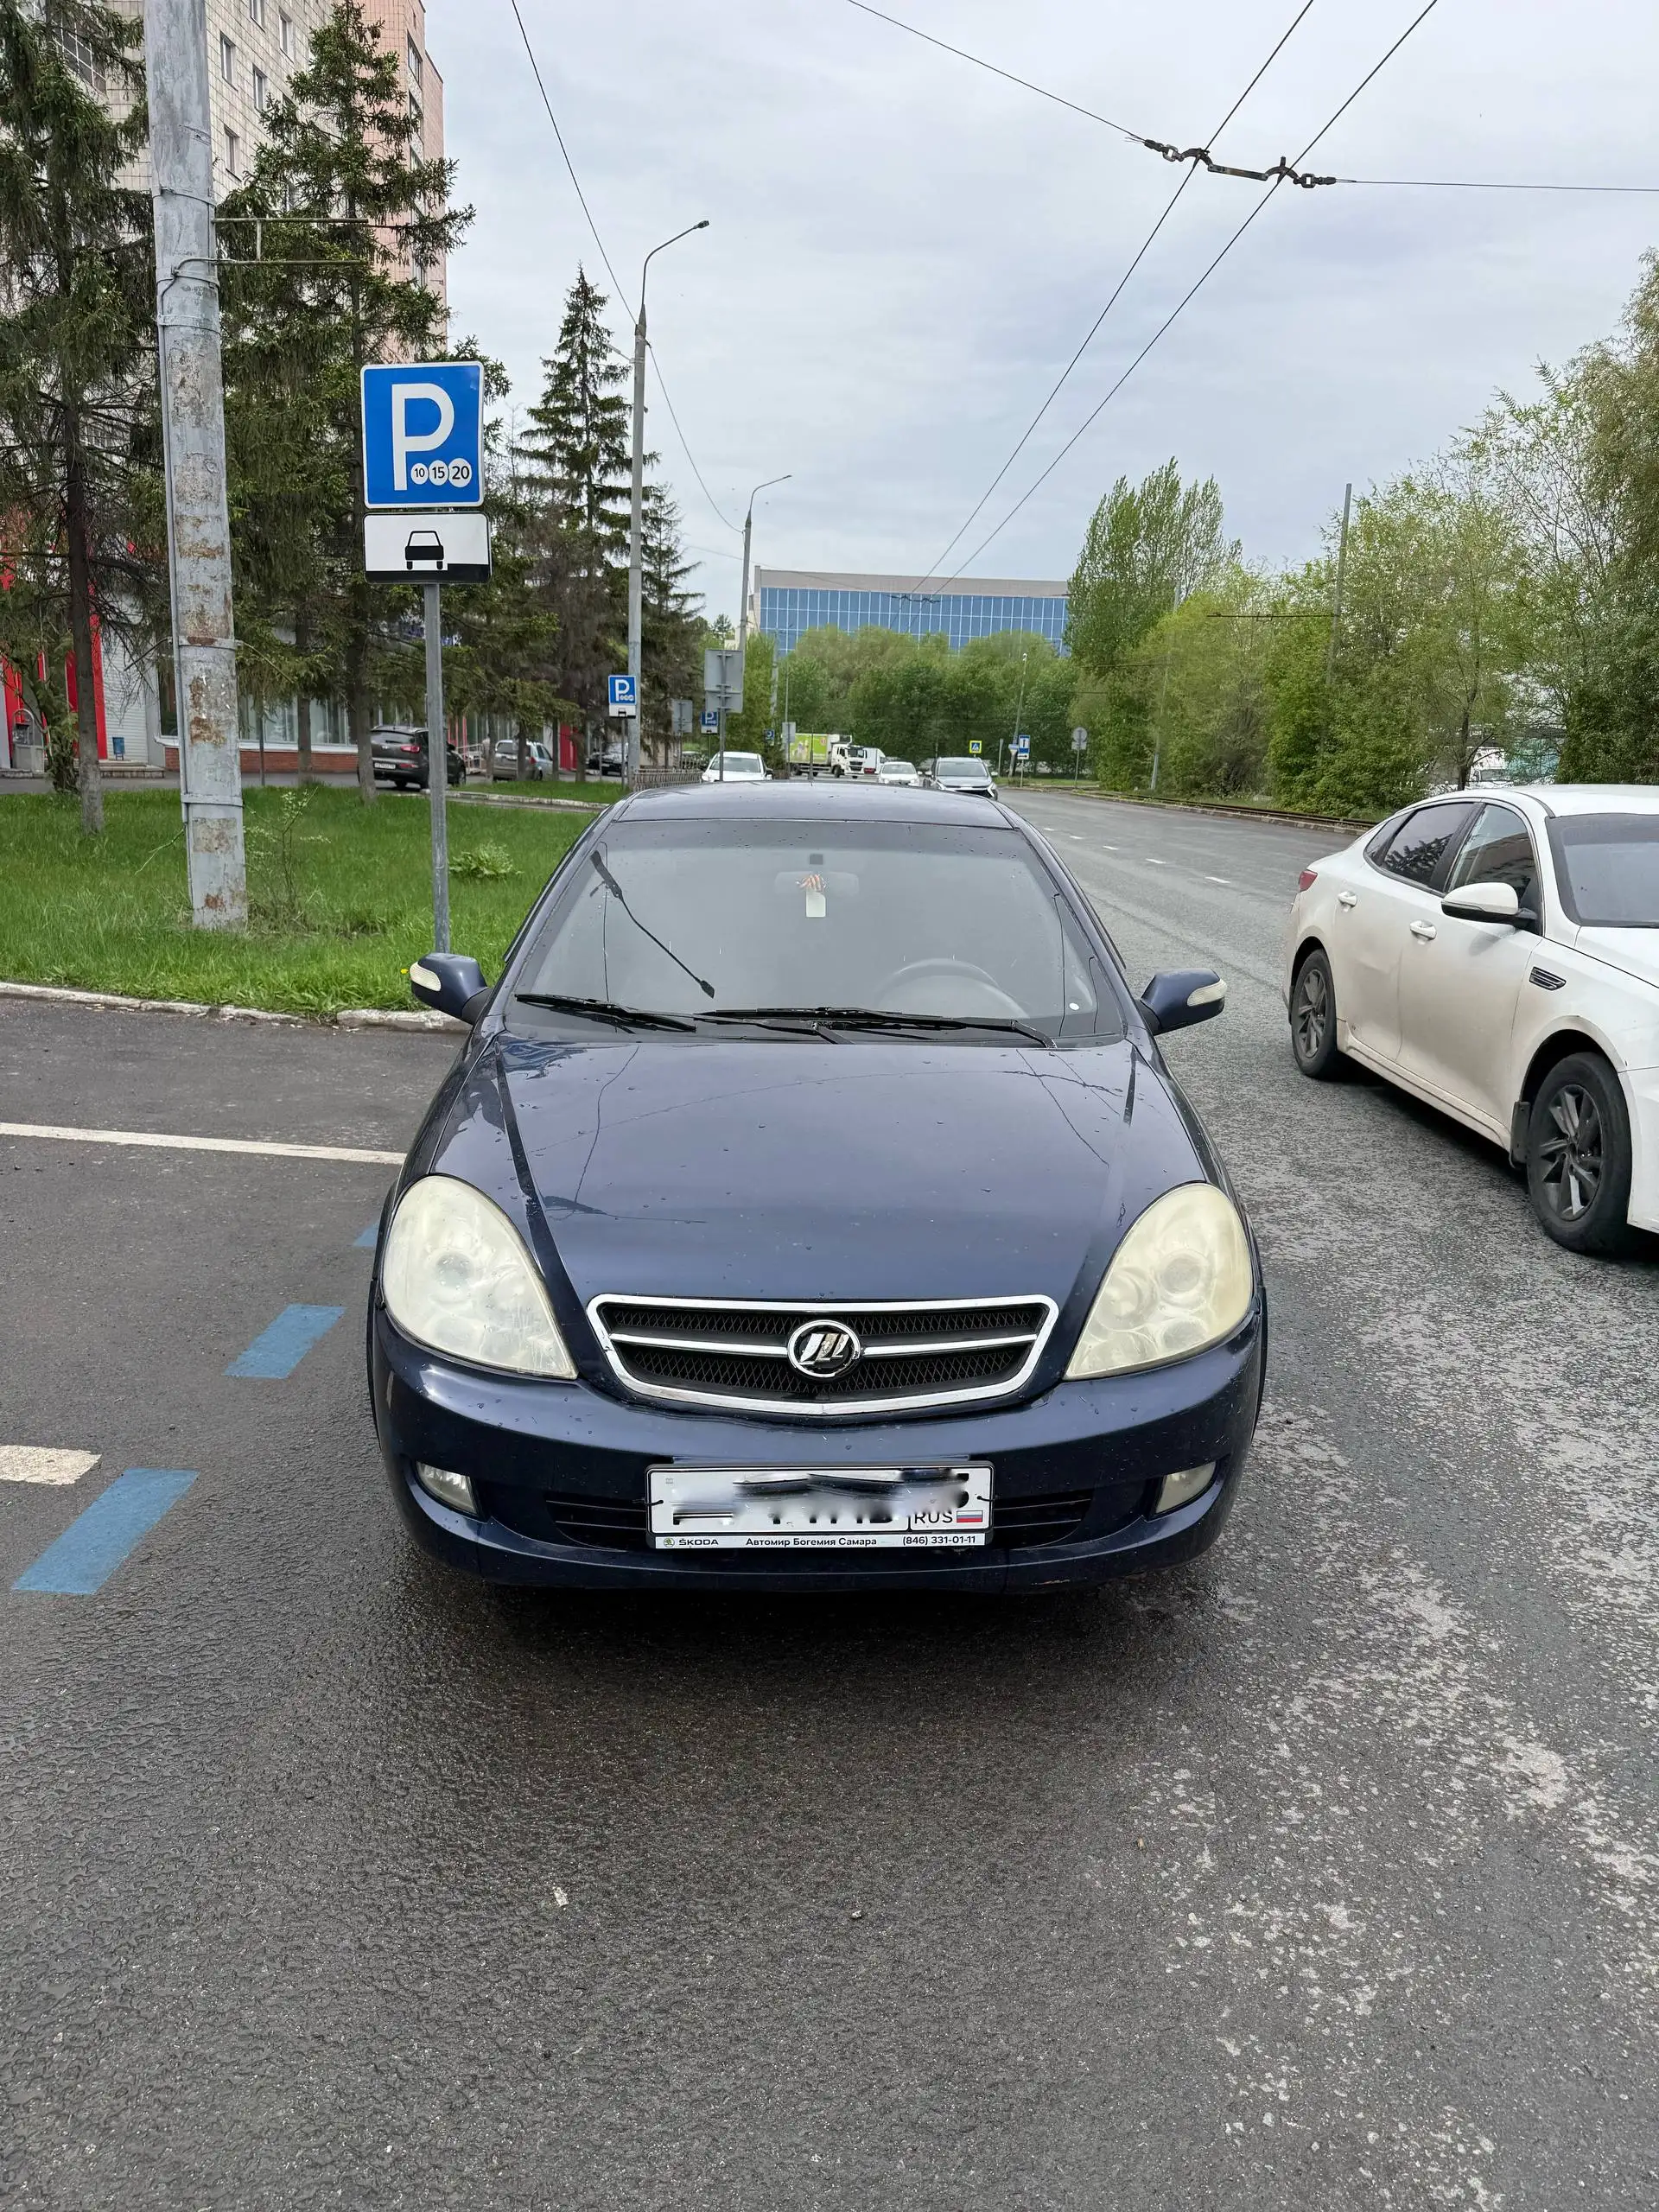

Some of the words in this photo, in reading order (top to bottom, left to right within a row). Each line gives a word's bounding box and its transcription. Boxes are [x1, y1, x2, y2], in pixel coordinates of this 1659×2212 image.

[391, 383, 454, 490] P
[414, 467, 425, 478] 10
[432, 467, 445, 479] 15
[451, 466, 470, 480] 20
[615, 679, 630, 701] P
[746, 1538, 791, 1548] Автомир
[793, 1537, 836, 1546] Богемия
[838, 1537, 877, 1547] Самара
[902, 1535, 928, 1546] (846)
[931, 1535, 976, 1545] 331-01-11
